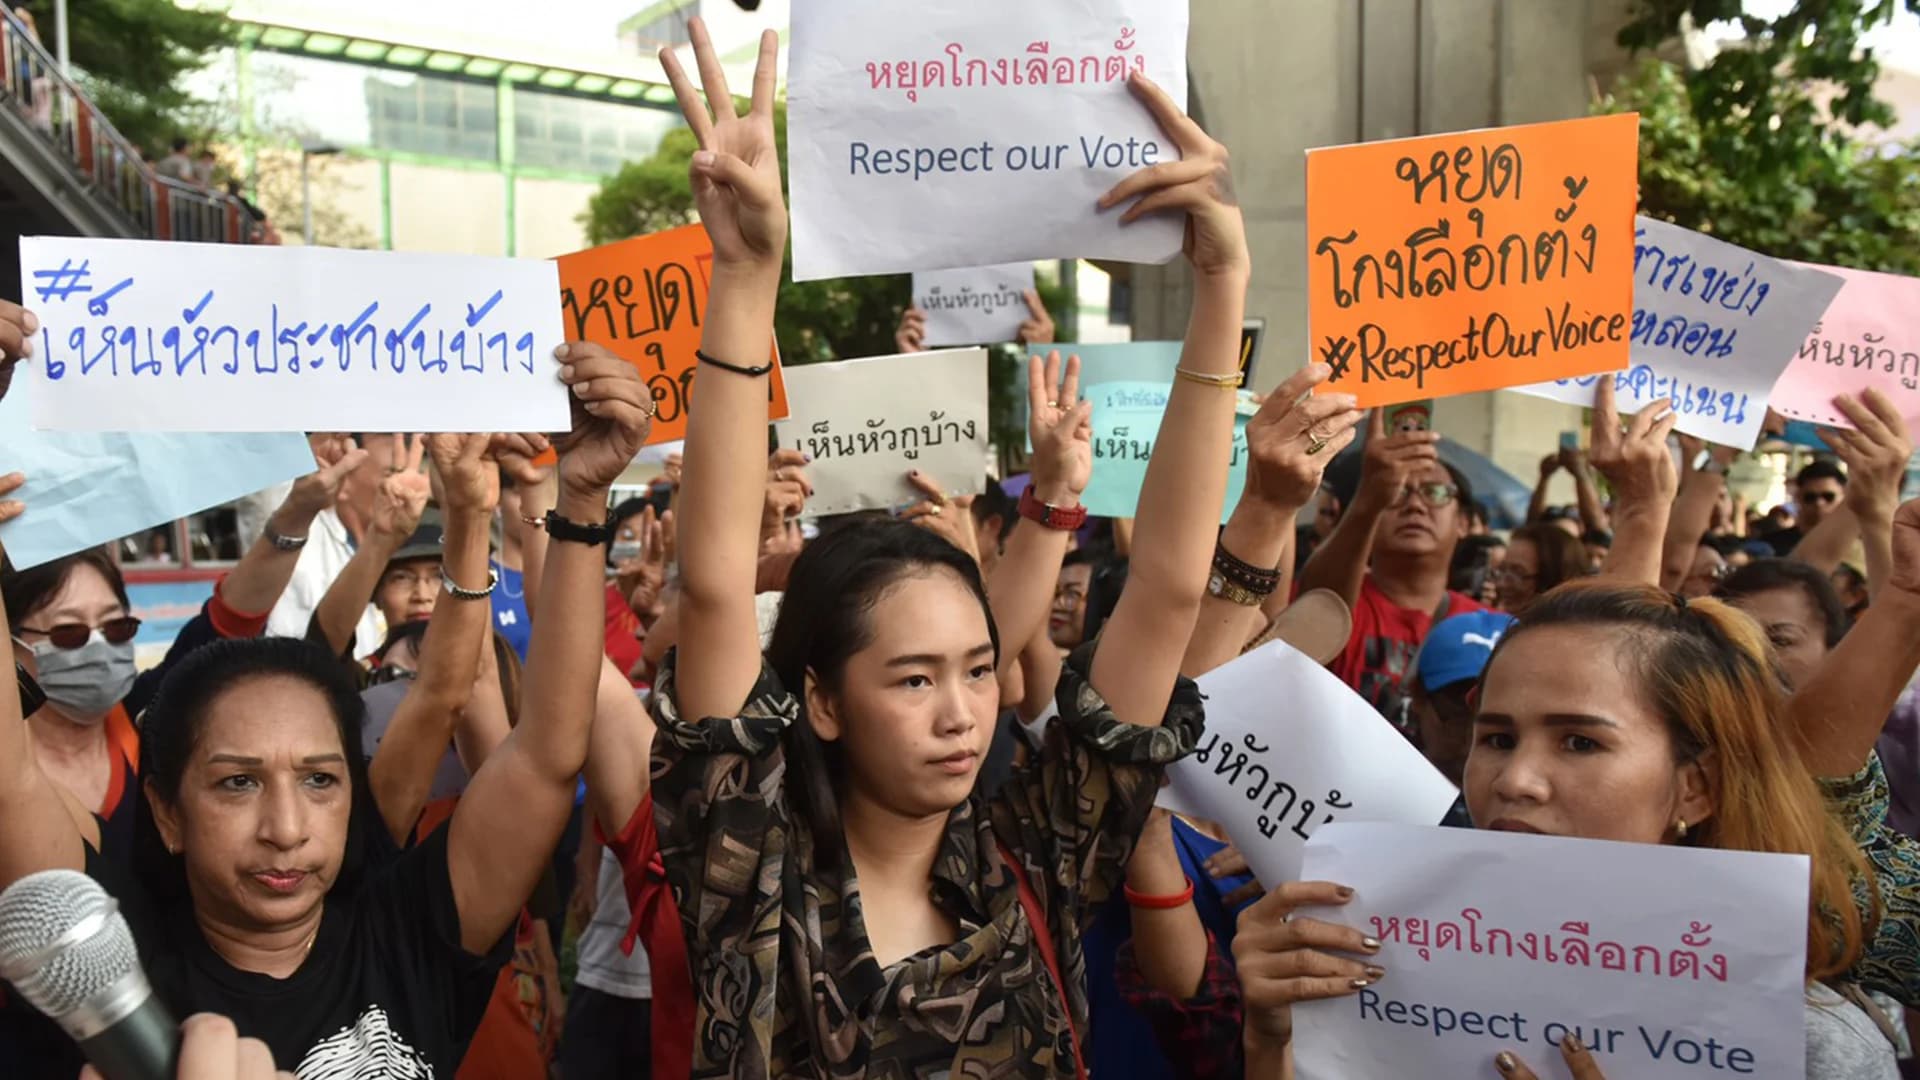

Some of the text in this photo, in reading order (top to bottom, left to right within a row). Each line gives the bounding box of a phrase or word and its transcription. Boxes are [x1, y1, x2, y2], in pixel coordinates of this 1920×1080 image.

[866, 28, 1145, 102] หยุดโกงเลือกตั้ง
[850, 136, 1159, 181] Respect our Vote
[1396, 143, 1523, 239] หยุด
[1316, 176, 1598, 309] โกงเลือกตั้ง
[1369, 908, 1728, 983] หยุดโกงเลือกตั้ง
[1358, 988, 1756, 1075] Respect our Vote
